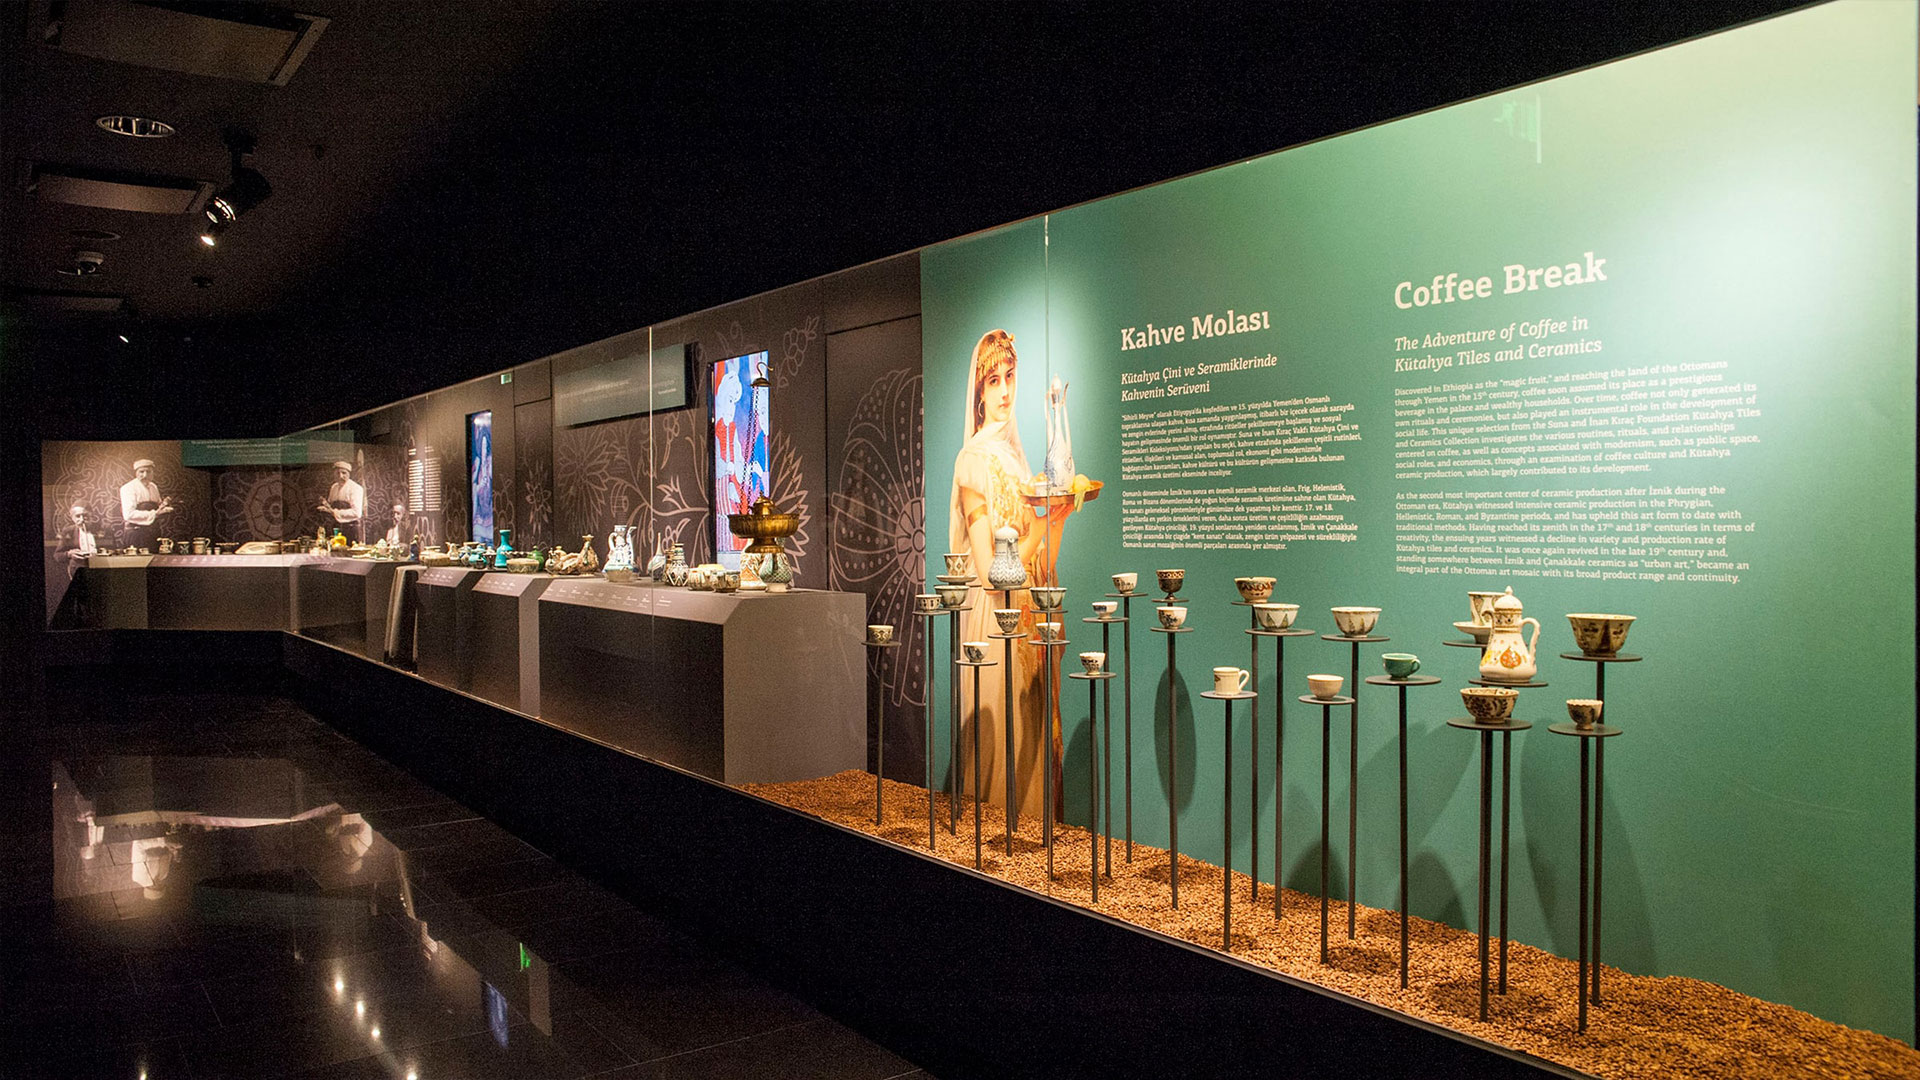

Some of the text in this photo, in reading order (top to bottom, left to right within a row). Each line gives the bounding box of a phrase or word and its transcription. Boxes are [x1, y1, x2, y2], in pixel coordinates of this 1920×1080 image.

[1394, 252, 1607, 309] Coffee Break
[1121, 310, 1270, 351] Kahve Molası
[1395, 316, 1588, 351] The Adventure of Coffee in
[1395, 338, 1602, 373] Kütahya Tiles and Ceramics
[1121, 353, 1277, 385] Kütahya Çini ve Seramiklerinde
[1121, 381, 1210, 401] Kahvenin Serüveni
[1394, 406, 1426, 418] beverage
[1427, 406, 1434, 414] in
[1436, 404, 1448, 413] the
[1449, 403, 1473, 414] palace
[1474, 401, 1489, 411] and
[1490, 399, 1522, 411] wealthy
[1574, 393, 1594, 404] Over
[1620, 389, 1647, 400] coffee
[1650, 389, 1665, 398] not
[1668, 386, 1688, 399] only
[1691, 382, 1740, 397] generated
[1744, 382, 1756, 392] its
[1395, 428, 1415, 437] social
[1431, 426, 1447, 435] This
[1448, 425, 1474, 436] unique
[1475, 422, 1509, 433] selection
[1511, 421, 1530, 430] from
[1532, 420, 1546, 429] the
[1547, 418, 1568, 428] Suna
[1570, 417, 1586, 427] and
[1589, 416, 1609, 426] İnan
[1611, 414, 1634, 427] Kıraç
[1637, 411, 1689, 423] Foundation
[1692, 408, 1733, 422] Kütahya
[1737, 406, 1760, 418] Tiles
[1395, 491, 1405, 499] As
[1405, 491, 1418, 499] the
[1418, 490, 1443, 499] second
[1464, 490, 1502, 500] important
[1504, 489, 1529, 497] center
[1530, 488, 1539, 497] of
[1541, 488, 1573, 497] ceramic
[1575, 486, 1622, 498] production
[1624, 486, 1646, 495] after
[1649, 485, 1672, 495] İznik
[1674, 485, 1707, 496] during
[1709, 484, 1725, 494] the
[1395, 522, 1432, 530] traditional
[1468, 522, 1496, 532] Having
[1497, 522, 1528, 531] reached
[1529, 522, 1540, 531] its
[1542, 521, 1568, 531] zenith
[1570, 522, 1578, 531] in
[1580, 521, 1595, 531] the
[1615, 521, 1633, 531] and
[1653, 522, 1698, 531] centuries
[1700, 522, 1710, 531] in
[1712, 522, 1742, 531] terms
[1744, 521, 1755, 531] of
[1464, 511, 1479, 520] and
[1480, 511, 1519, 521] Byzantine
[1553, 510, 1569, 519] and
[1571, 510, 1587, 519] has
[1588, 510, 1618, 521] upheld
[1620, 510, 1638, 519] this
[1640, 511, 1654, 519] art
[1656, 509, 1679, 519] form
[1681, 510, 1691, 519] to
[1693, 509, 1715, 519] date
[1717, 509, 1741, 519] with
[1396, 543, 1425, 553] Kütahya
[1426, 543, 1442, 552] tiles
[1443, 544, 1457, 552] and
[1495, 544, 1502, 553] It
[1521, 546, 1541, 554] once
[1542, 546, 1565, 556] again
[1566, 545, 1598, 554] revived
[1600, 546, 1609, 555] in
[1611, 546, 1626, 555] the
[1628, 546, 1646, 555] late
[1667, 547, 1705, 558] century
[1396, 553, 1426, 564] standing
[1427, 554, 1468, 563] somewhere
[1470, 555, 1502, 564] between
[1504, 555, 1524, 564] İznik
[1525, 556, 1541, 565] and
[1542, 556, 1585, 568] Çanakkale
[1587, 558, 1626, 567] ceramics
[1627, 559, 1638, 567] as
[1696, 559, 1734, 569] became
[1736, 561, 1749, 570] an
[1396, 564, 1423, 574] integral
[1424, 566, 1439, 575] part
[1440, 565, 1448, 574] of
[1450, 565, 1462, 574] the
[1464, 566, 1497, 575] Ottoman
[1498, 567, 1510, 575] art
[1512, 568, 1540, 576] mosaic
[1541, 568, 1561, 577] with
[1563, 569, 1574, 577] its
[1575, 568, 1601, 578] broad
[1602, 569, 1636, 581] product
[1638, 572, 1665, 582] range
[1667, 571, 1685, 581] and
